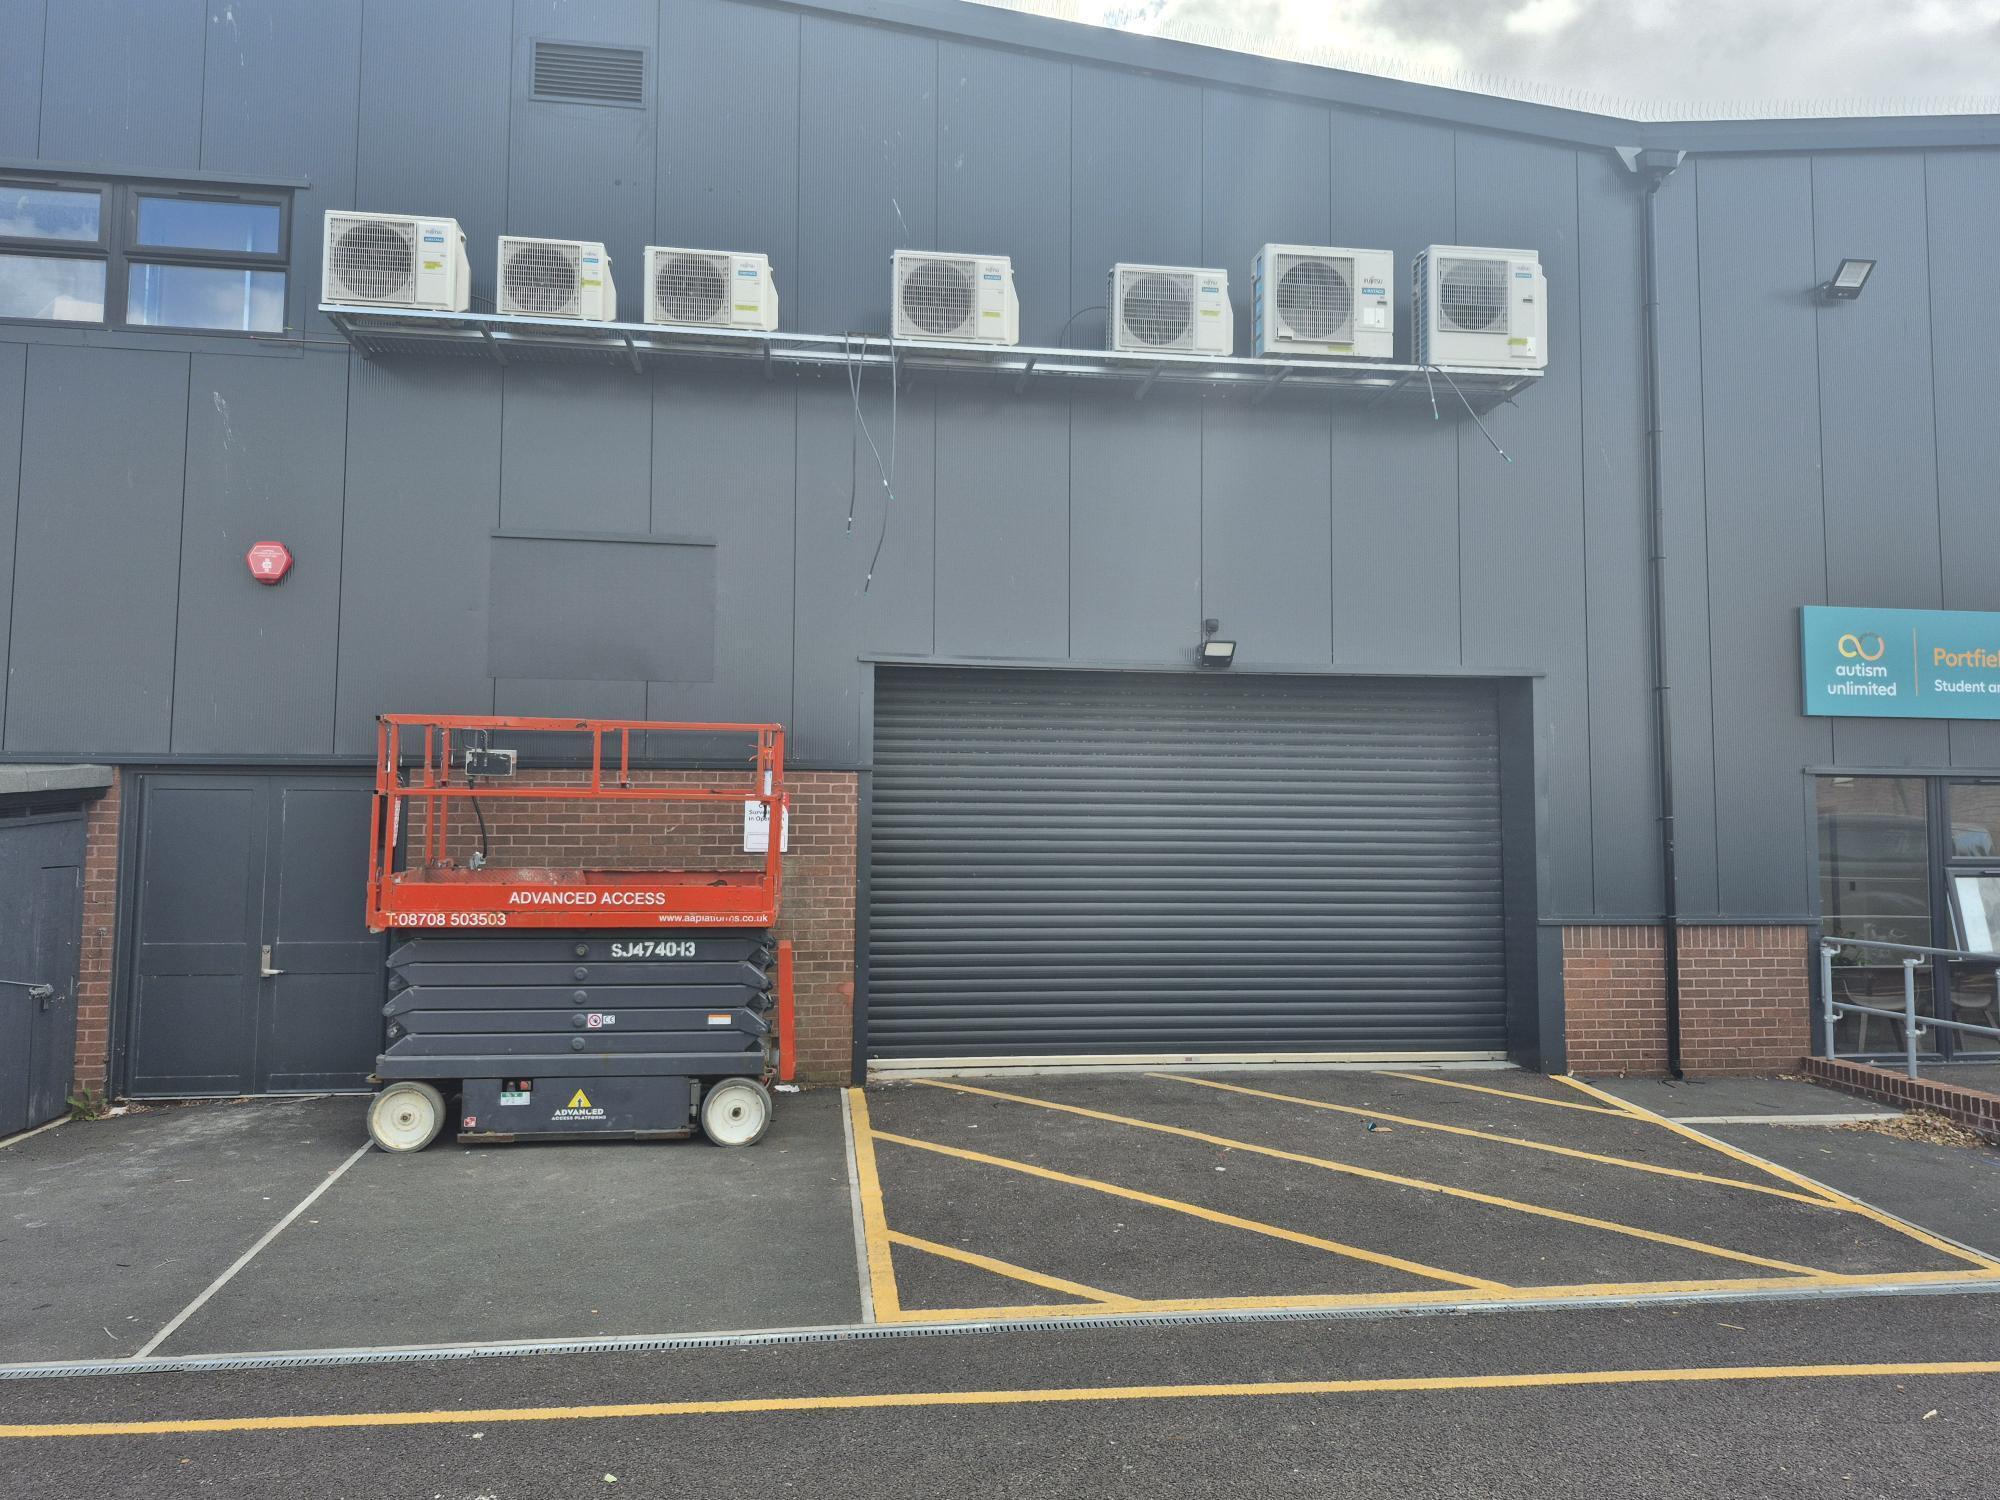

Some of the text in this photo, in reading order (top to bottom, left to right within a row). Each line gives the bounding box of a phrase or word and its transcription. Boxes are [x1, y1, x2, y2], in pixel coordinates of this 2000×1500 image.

[1836, 663, 1888, 677] autism
[1828, 681, 1897, 696] unlimited
[1934, 679, 1986, 693] Student
[509, 891, 666, 905] ADVANCED ACCESS
[386, 912, 507, 926] T:08708 503503
[554, 1108, 604, 1116] ADVANCED
